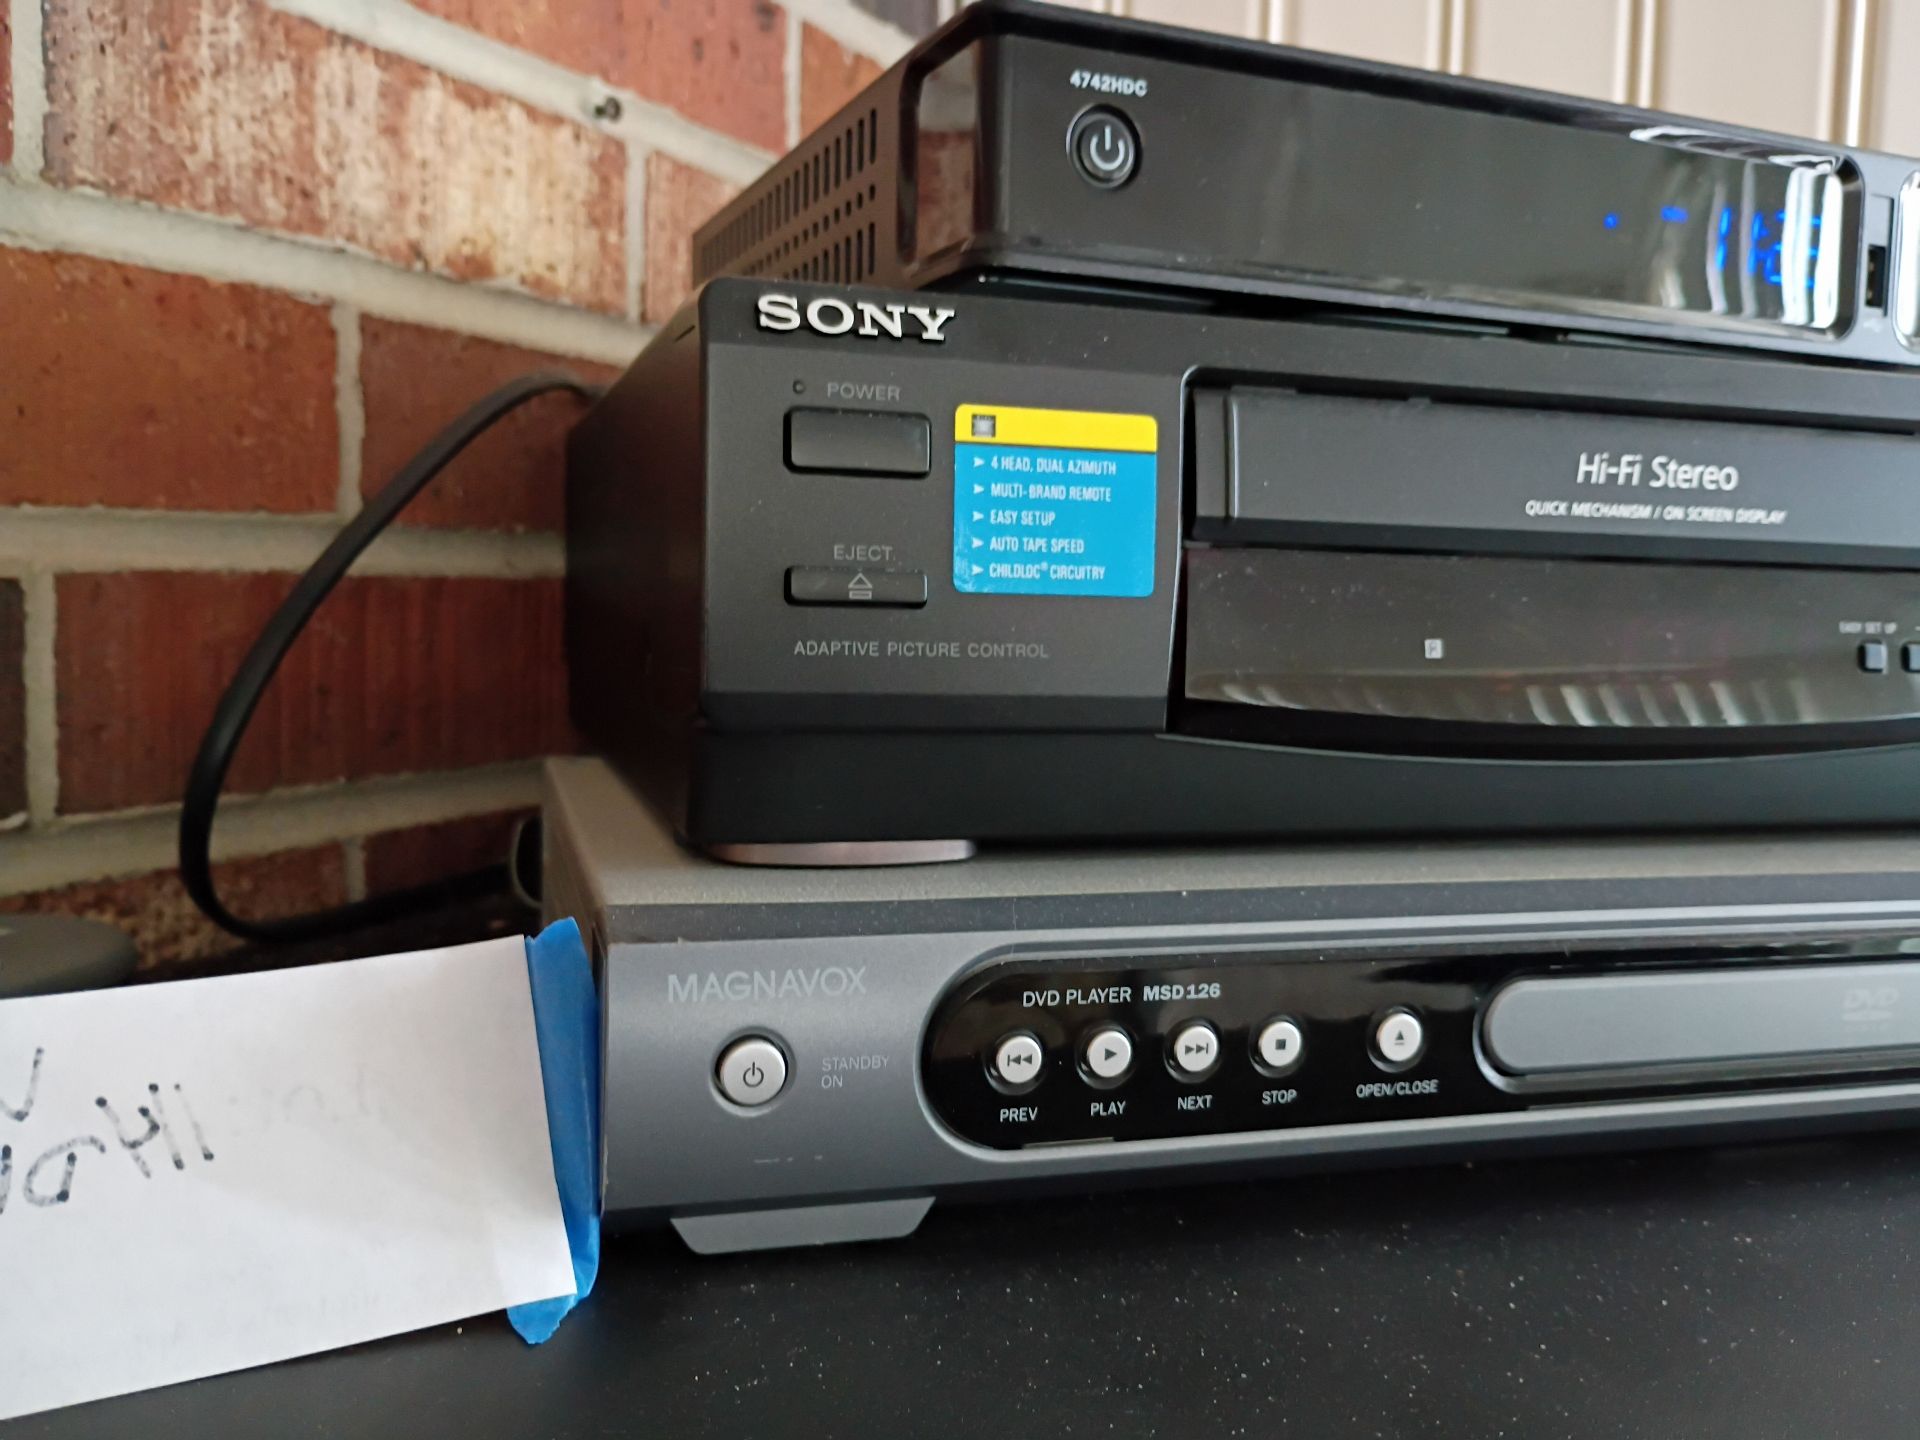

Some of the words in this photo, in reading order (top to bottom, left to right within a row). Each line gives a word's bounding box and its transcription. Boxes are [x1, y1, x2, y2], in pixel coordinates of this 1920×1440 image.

[757, 294, 956, 341] SONY
[827, 382, 901, 400] POWER
[991, 455, 999, 470] 4
[1036, 458, 1064, 474] DUAL
[1067, 458, 1117, 475] AZIMUTH
[1576, 452, 1643, 486] Hi-Fi
[1649, 455, 1739, 491] Stereo
[1069, 486, 1111, 502] REMOTE
[990, 509, 1018, 525] EASY
[1020, 511, 1056, 526] SETUP
[1525, 500, 1568, 517] QUICK
[1571, 501, 1653, 520] MECHANISM
[1662, 505, 1686, 521] ON
[1687, 505, 1733, 523] SCREEN
[1735, 508, 1787, 524] DISPLAY
[833, 544, 894, 561] EJECT
[989, 536, 1018, 552] AUTO
[1022, 537, 1047, 553] TAPE
[1050, 538, 1084, 554] SPEED
[1050, 564, 1106, 580] CIRCUITRY
[794, 640, 879, 657] ADAPTIVE
[887, 641, 961, 658] PICTURE
[967, 642, 1049, 659] CONTROL
[667, 966, 866, 1002] MAGNAVOX
[1022, 990, 1060, 1008] DVD
[1065, 986, 1132, 1004] PLAYER
[1143, 983, 1221, 1002] MSD126
[821, 1055, 890, 1072] STANDBY
[821, 1075, 843, 1089] ON
[1356, 1079, 1439, 1098] OPEN/CLOSE
[1177, 1095, 1213, 1111] NEXT
[1262, 1089, 1297, 1106] STOP
[1000, 1106, 1038, 1123] PREV
[1090, 1101, 1126, 1117] PLAY
